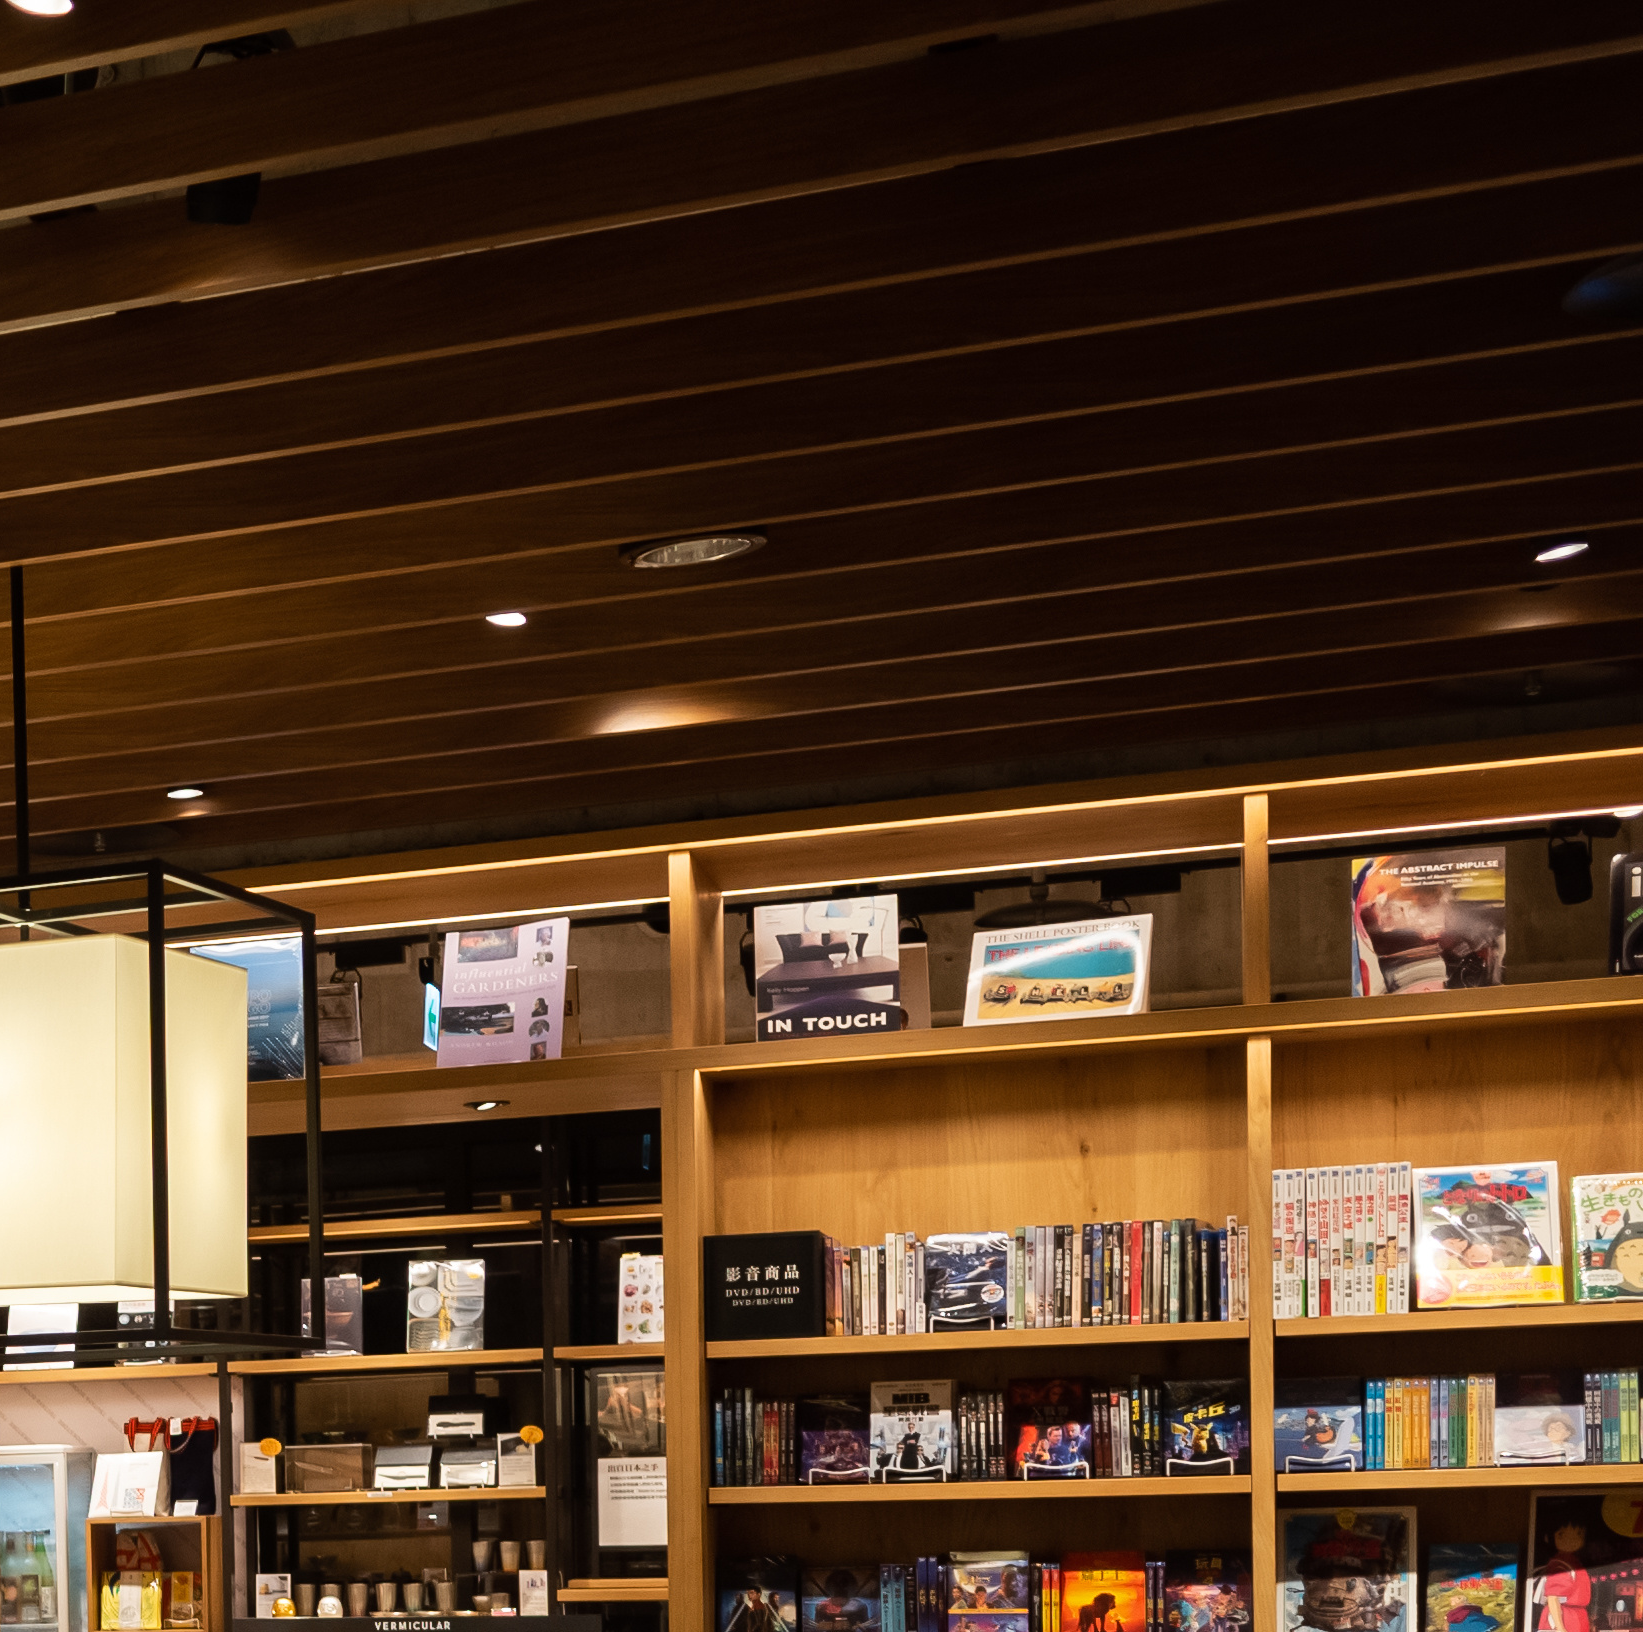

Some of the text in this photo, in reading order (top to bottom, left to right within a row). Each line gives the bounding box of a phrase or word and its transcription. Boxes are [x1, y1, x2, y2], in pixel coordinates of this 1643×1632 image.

[1379, 859, 1499, 876] THE ABSTRACT IMPULSE
[986, 934, 1009, 944] THE
[1013, 929, 1050, 942] SHELL
[454, 962, 529, 981] influential
[453, 970, 559, 994] GARDENERS
[767, 1011, 887, 1033] IN TOUCH
[725, 1262, 800, 1282] 影音商品
[374, 1621, 451, 1631] VERMICULAR
